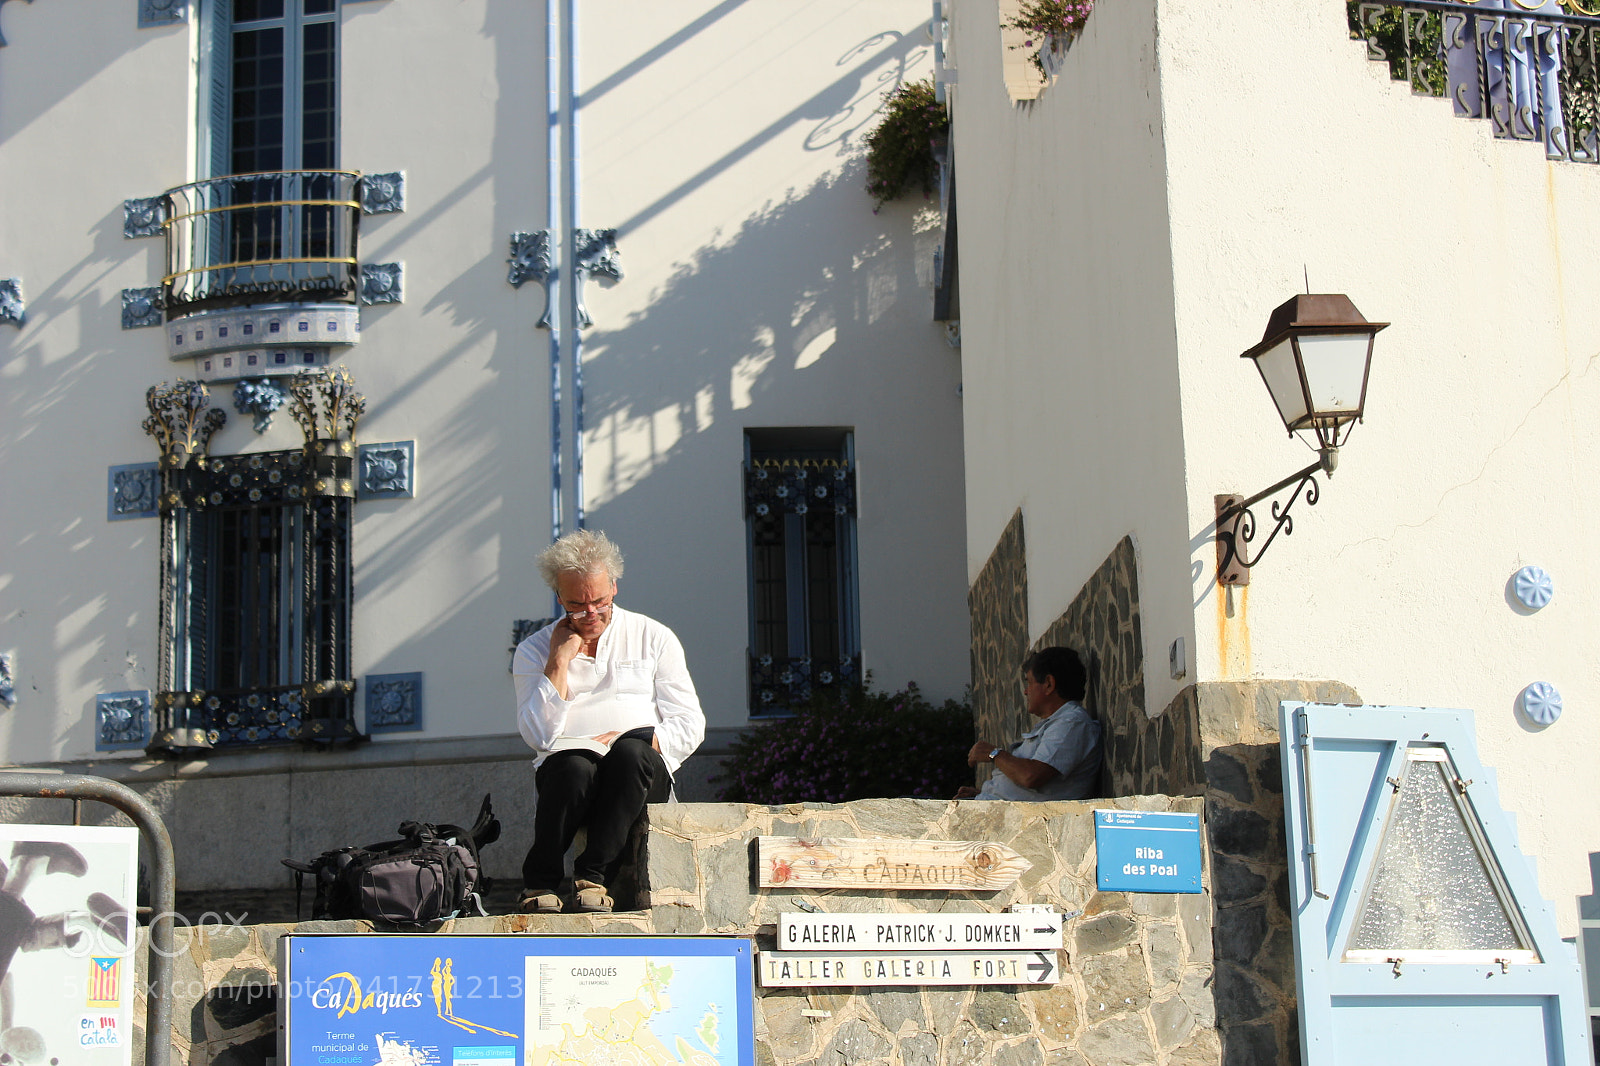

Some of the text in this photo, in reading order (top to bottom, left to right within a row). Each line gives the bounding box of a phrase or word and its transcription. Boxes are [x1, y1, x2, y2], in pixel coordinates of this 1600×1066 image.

[1135, 847, 1164, 860] Riba
[1122, 863, 1178, 876] des Poal
[788, 924, 1021, 943] GALERIA PATRICK J. DOMKEN
[768, 959, 1018, 980] TALLER GALERIA FORT
[80, 1018, 95, 1029] en
[326, 1031, 355, 1040] Terme
[311, 1043, 369, 1053] municipal de
[318, 1055, 363, 1065] Cadaqués
